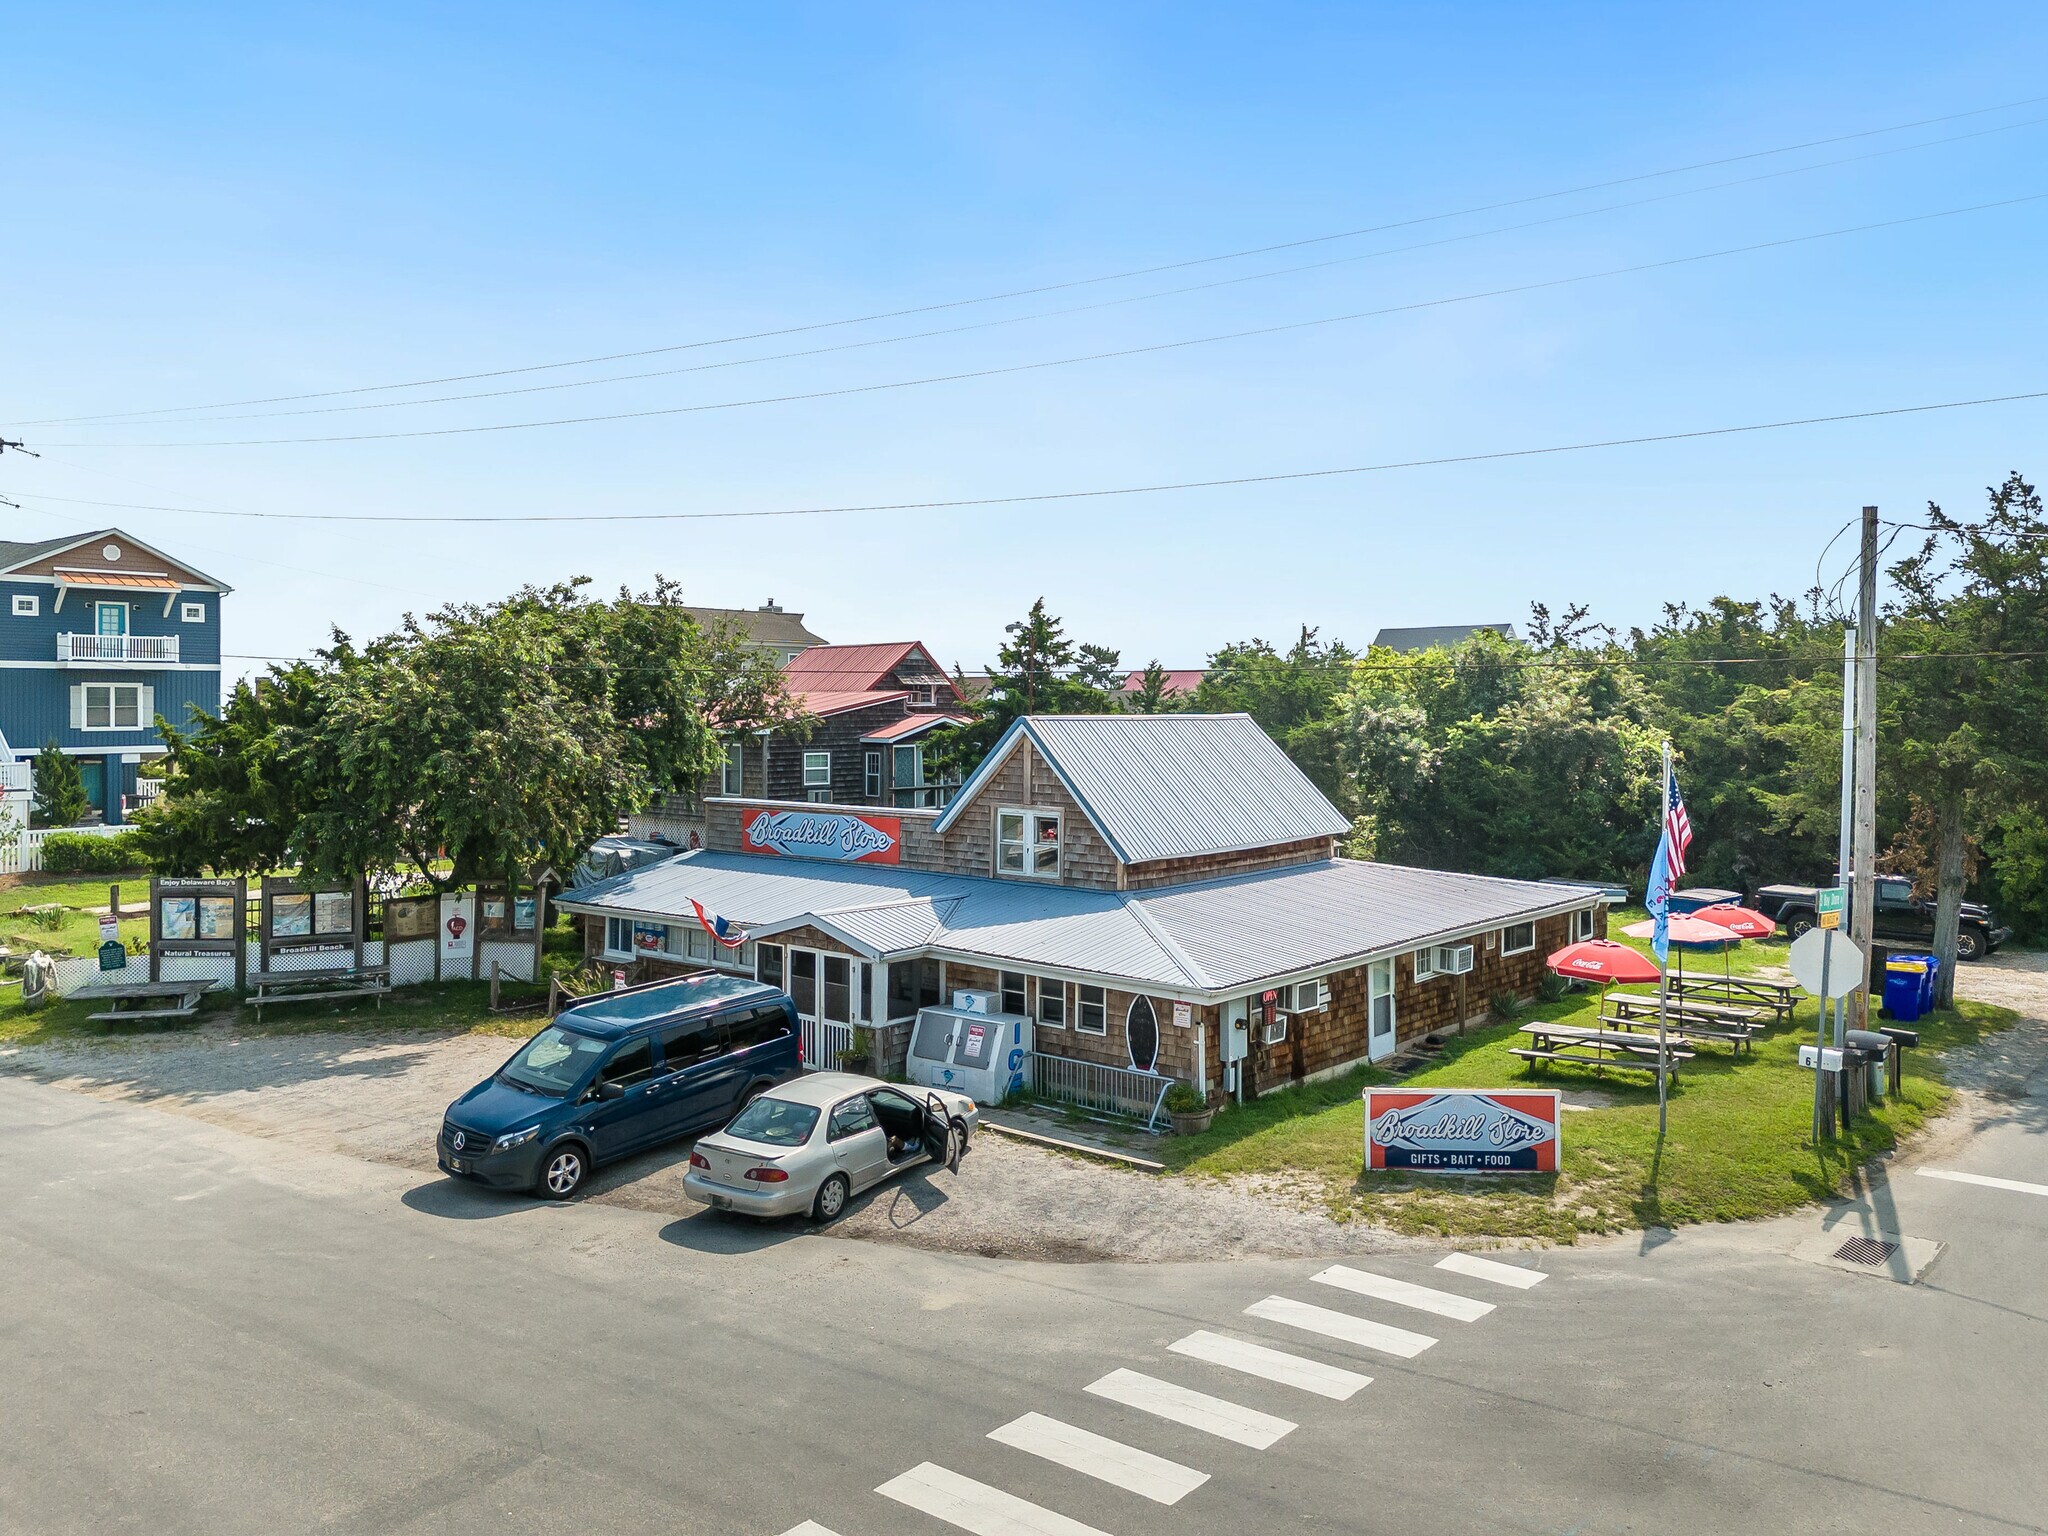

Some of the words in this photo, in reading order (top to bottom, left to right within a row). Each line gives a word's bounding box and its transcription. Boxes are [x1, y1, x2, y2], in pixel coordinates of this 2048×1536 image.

[751, 813, 837, 846] Broadkill
[840, 820, 890, 852] Store
[280, 946, 317, 954] Broadkill
[1262, 990, 1278, 1002] OPEN
[1376, 1109, 1487, 1143] Broadkill
[1488, 1112, 1546, 1146] Store
[1410, 1153, 1440, 1165] GIFTS
[1450, 1154, 1474, 1165] BAIT
[1484, 1154, 1511, 1165] FOOD
